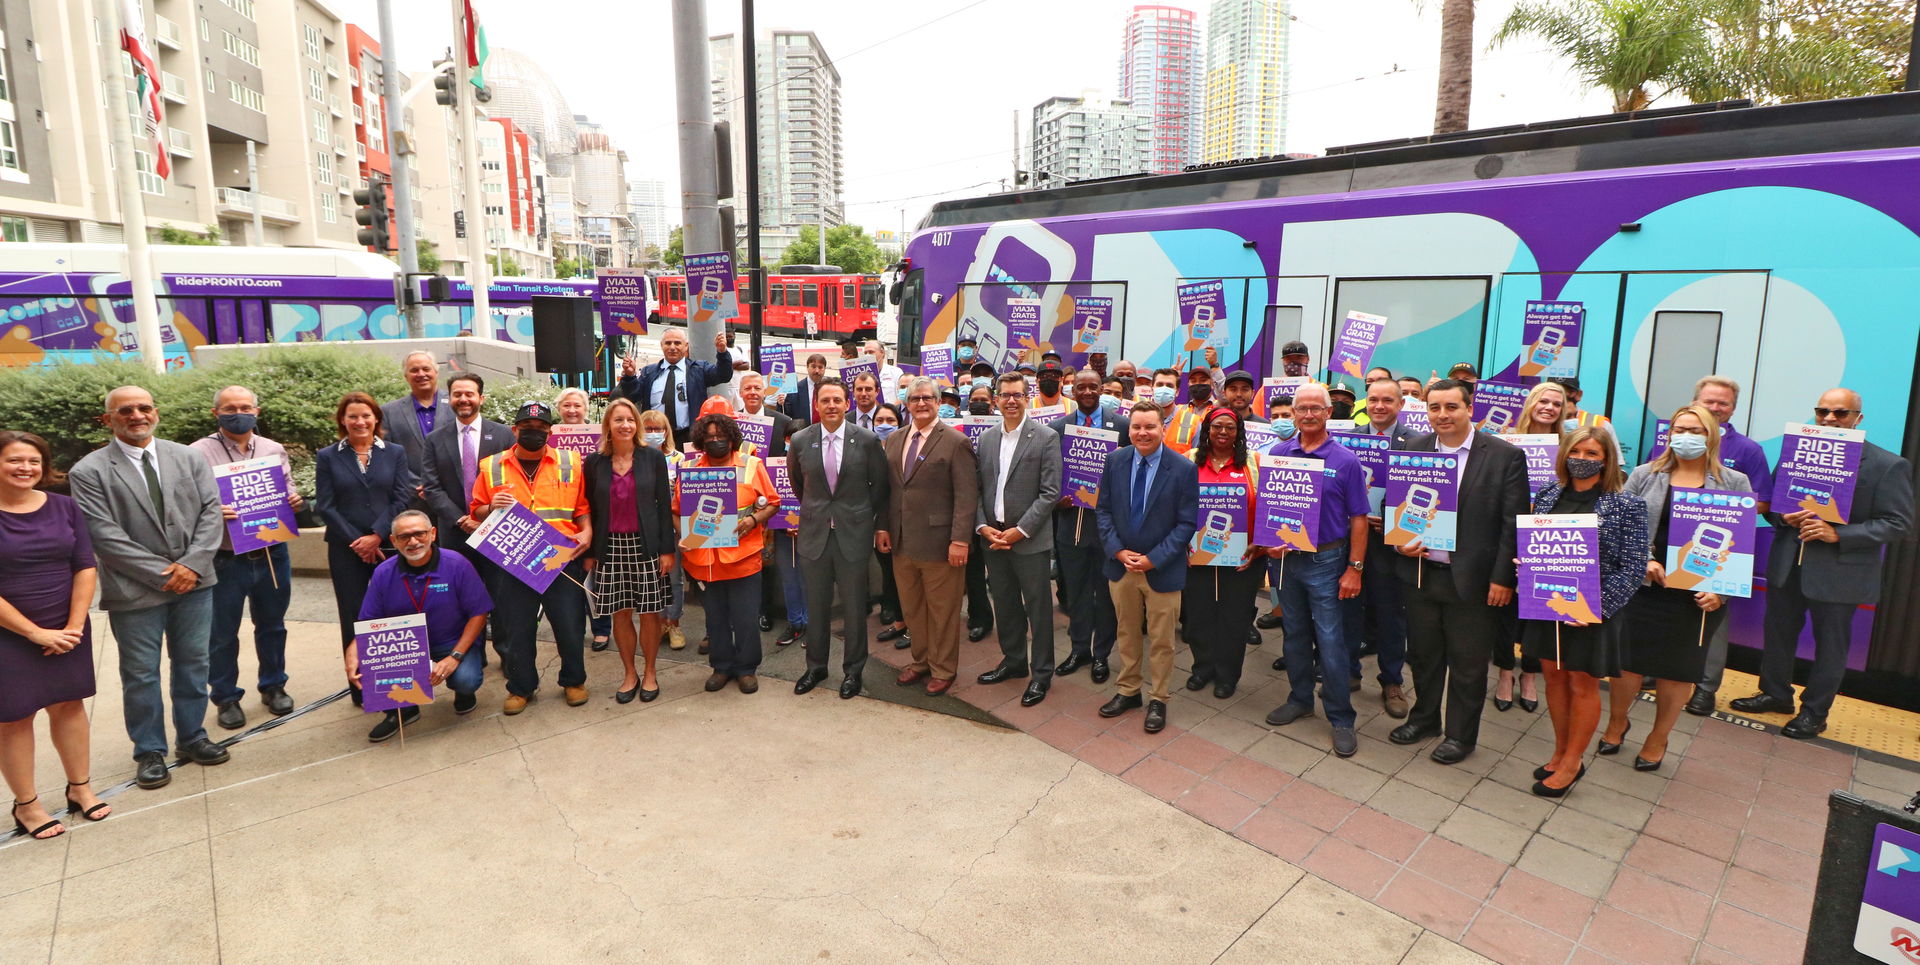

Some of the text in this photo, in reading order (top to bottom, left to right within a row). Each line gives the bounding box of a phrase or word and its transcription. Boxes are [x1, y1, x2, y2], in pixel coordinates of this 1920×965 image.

[932, 232, 952, 246] 4017
[685, 254, 730, 266] PRONTO
[175, 276, 282, 288] RidePRONTO.com
[606, 278, 638, 287] ¡VIAJA
[456, 283, 575, 294] Metolitan Transit System
[604, 286, 640, 295] GRATIS
[1179, 282, 1222, 296] PRONTO
[1076, 298, 1112, 306] PRONTO
[0, 296, 75, 325] RONTO
[1527, 304, 1582, 314] PRONTO
[1350, 321, 1376, 332] ¡VIAJA
[1346, 328, 1375, 340] GRATIS
[1477, 382, 1531, 396] PRONTO
[1476, 392, 1497, 401] Always
[1406, 414, 1430, 424] ¡VIA
[737, 422, 764, 433] VIAJA
[558, 436, 593, 446] ¡VIAJA
[741, 433, 765, 442] RATIS
[1245, 433, 1273, 441] VIAJA
[1072, 438, 1108, 452] ¡VIAJA
[1797, 438, 1846, 455] RIDE
[1069, 448, 1107, 462] GRATIS
[1793, 450, 1844, 468] FREE
[1078, 460, 1105, 469] septiem
[1389, 455, 1457, 469] PRONTO
[681, 470, 736, 481] PRONTO
[1080, 466, 1103, 474] PRONTO
[1389, 468, 1416, 476] Always
[1795, 463, 1854, 478] September
[230, 470, 273, 488] RIDE
[1269, 470, 1312, 483] ¡VIAJA
[1807, 473, 1844, 484] PRONTO!
[232, 481, 277, 500] FREE
[1200, 486, 1246, 496] RONTO
[1266, 482, 1314, 494] GRATIS
[238, 492, 286, 508] September
[1277, 493, 1318, 503] septiembre
[1673, 491, 1755, 508] PRONTO
[252, 500, 282, 511] PRONTO!
[1280, 501, 1310, 509] PRONTO!
[1673, 504, 1743, 518] Obtén siempre
[1682, 512, 1710, 522] mejor
[1712, 515, 1740, 524] tarifa.
[486, 512, 520, 547] RIDE
[497, 518, 532, 555] FREE
[1530, 530, 1584, 544] ¡VIAJA
[502, 520, 543, 566] all September
[513, 529, 545, 566] with PRONTO!
[1527, 543, 1589, 556] GRATIS
[1543, 556, 1595, 566] septiembre
[368, 629, 416, 647] ¡VIAJA
[366, 640, 420, 657] GRATIS
[362, 651, 426, 665] todo septiembre
[385, 658, 419, 669] PRONTO!
[1710, 711, 1766, 731] Line
